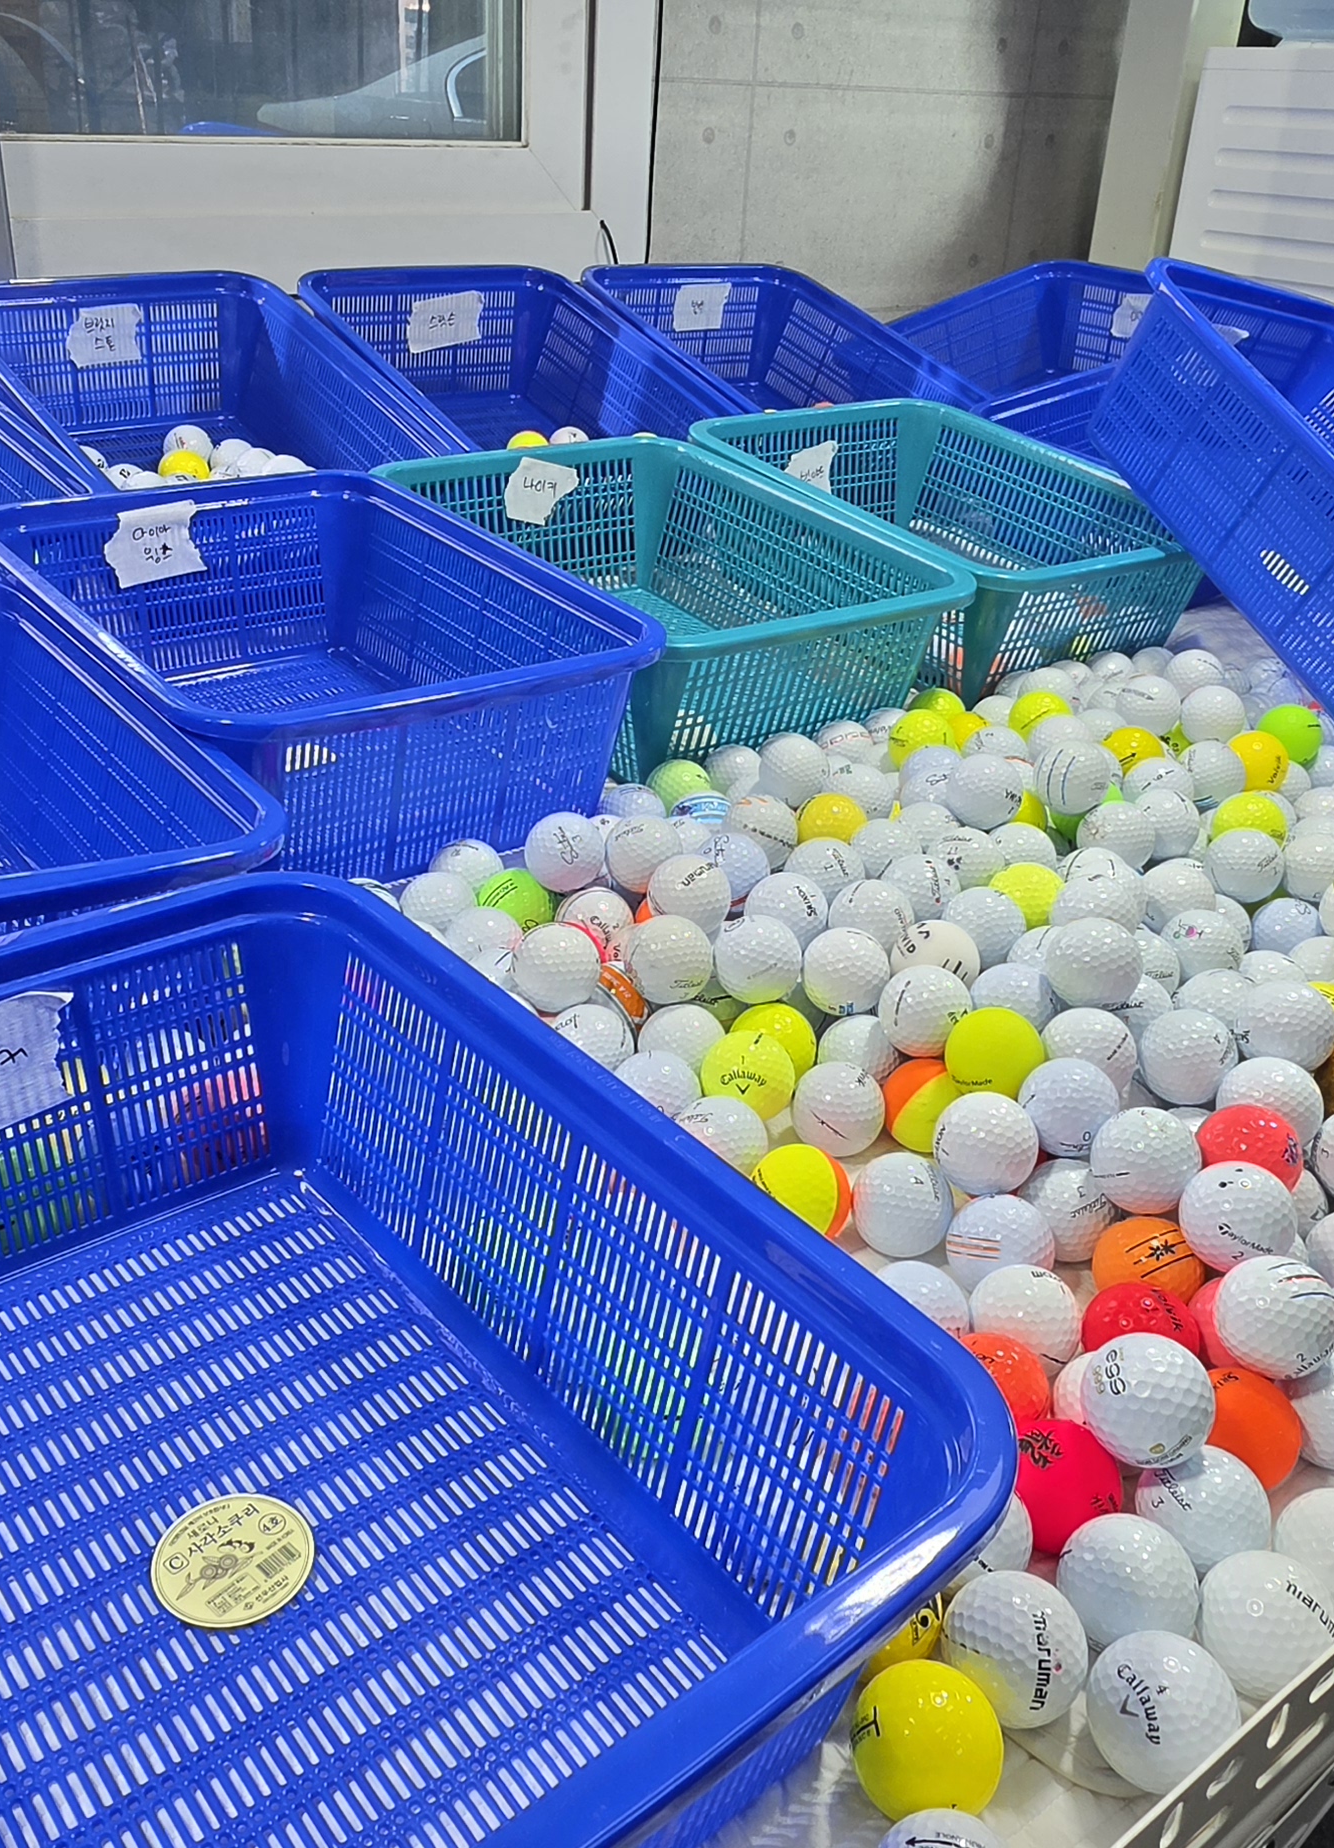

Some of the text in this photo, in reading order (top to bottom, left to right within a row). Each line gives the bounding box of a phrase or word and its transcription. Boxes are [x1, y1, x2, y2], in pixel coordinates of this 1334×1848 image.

[523, 477, 557, 498] 나이키
[132, 524, 171, 541] 다이아
[720, 1069, 768, 1087] Callaway
[1218, 1222, 1275, 1255] TaylorMade
[1105, 1348, 1127, 1396] egg
[1153, 1467, 1193, 1512] Titleist
[187, 1502, 261, 1559] 사각소쿠리
[261, 1516, 285, 1534] 4호
[1032, 1611, 1053, 1713] maruman
[1117, 1663, 1162, 1746] Callaway
